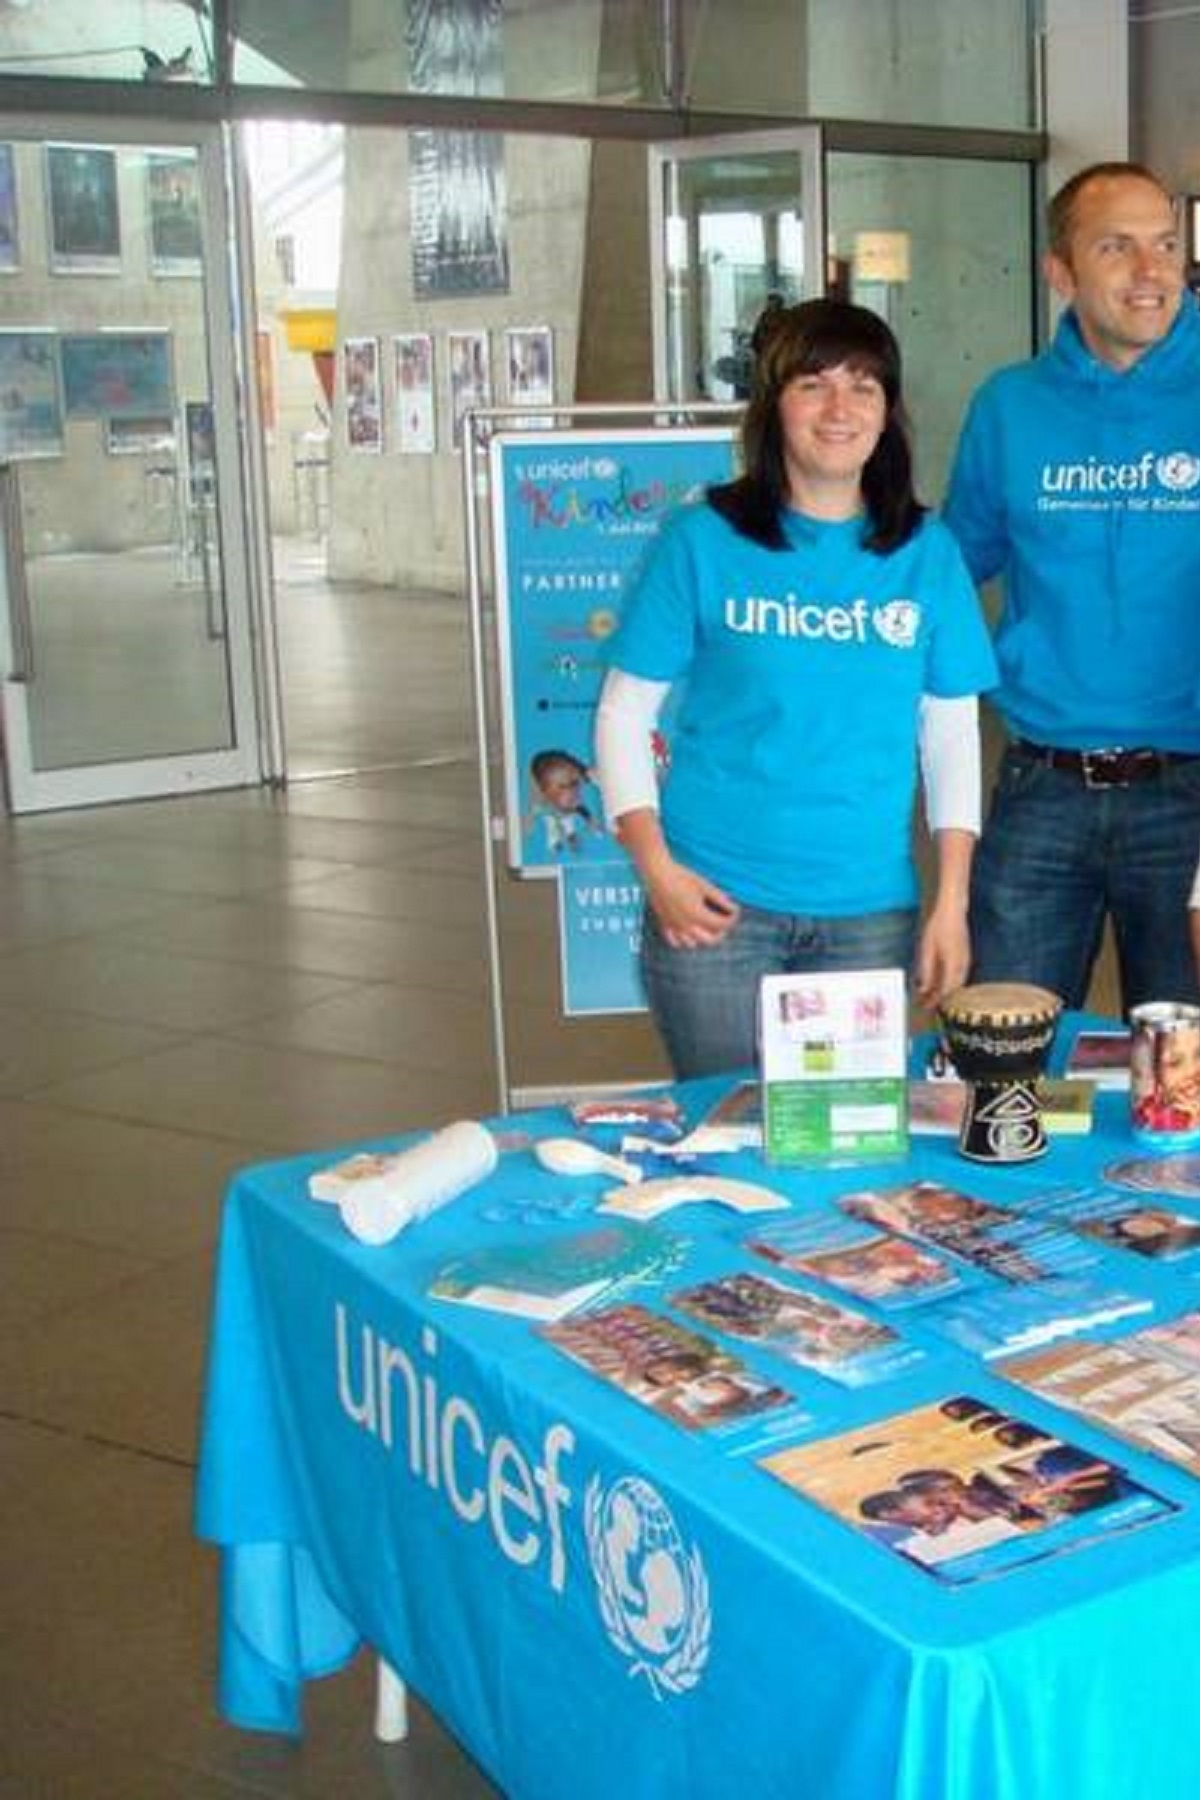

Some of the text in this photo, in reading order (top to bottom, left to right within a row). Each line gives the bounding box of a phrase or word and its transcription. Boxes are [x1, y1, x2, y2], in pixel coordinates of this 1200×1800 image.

[1042, 452, 1154, 491] unicef
[523, 573, 620, 593] PARTNER
[725, 594, 868, 643] unicef
[335, 1302, 575, 1593] unicef
